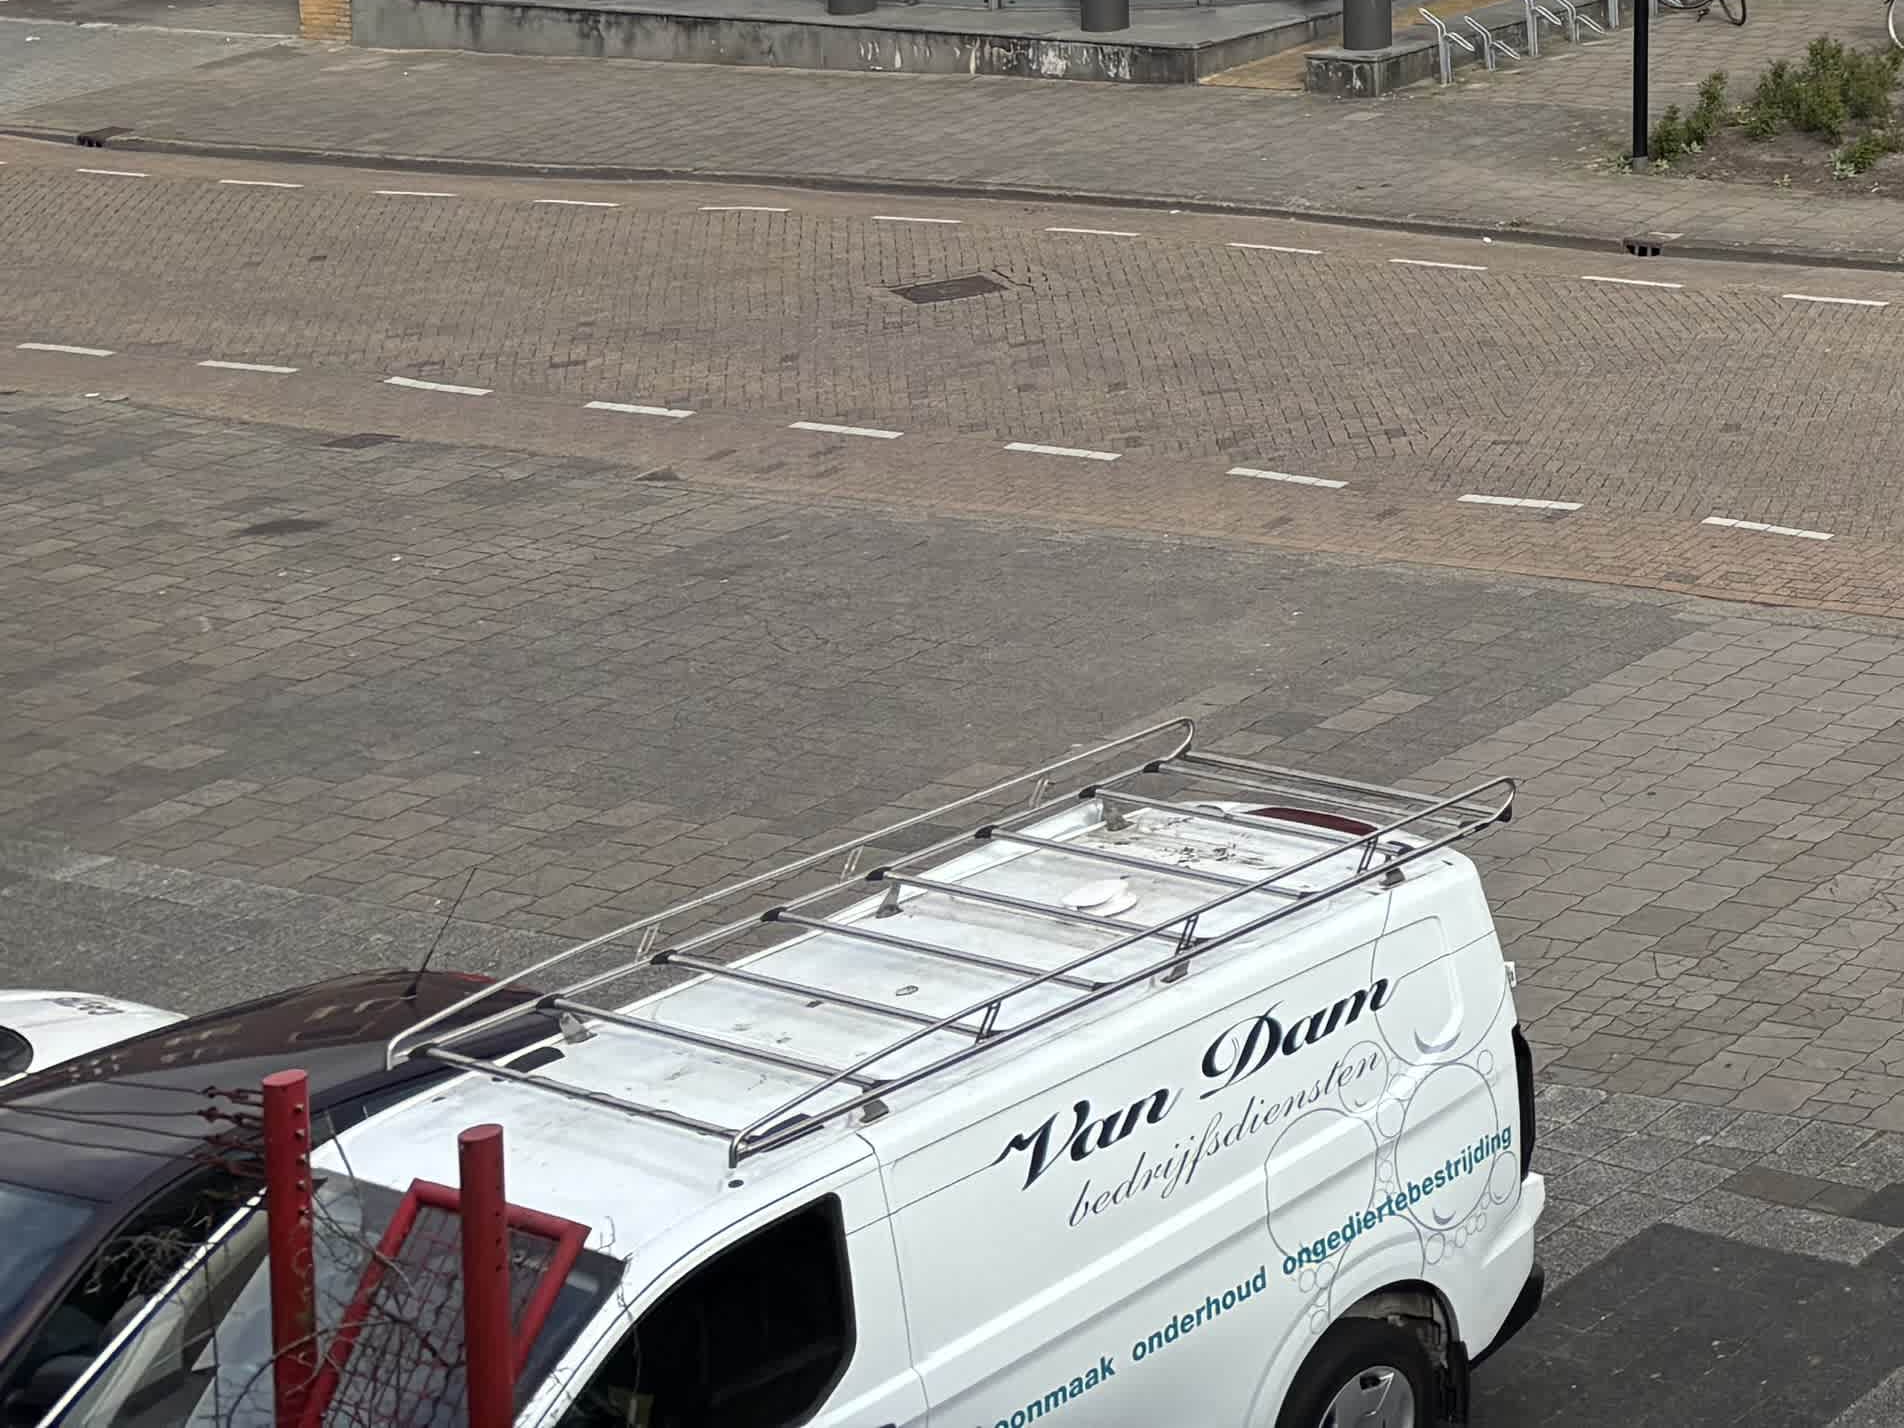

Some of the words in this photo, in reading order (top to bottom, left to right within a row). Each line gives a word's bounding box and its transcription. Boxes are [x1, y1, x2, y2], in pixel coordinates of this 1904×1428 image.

[992, 1087, 1184, 1192] Van
[1199, 978, 1398, 1101] Dam
[1068, 1051, 1380, 1227] bedrijfsdiensten
[1131, 1264, 1268, 1362] onderhoud
[1282, 1124, 1512, 1276] ongediertebestrijding
